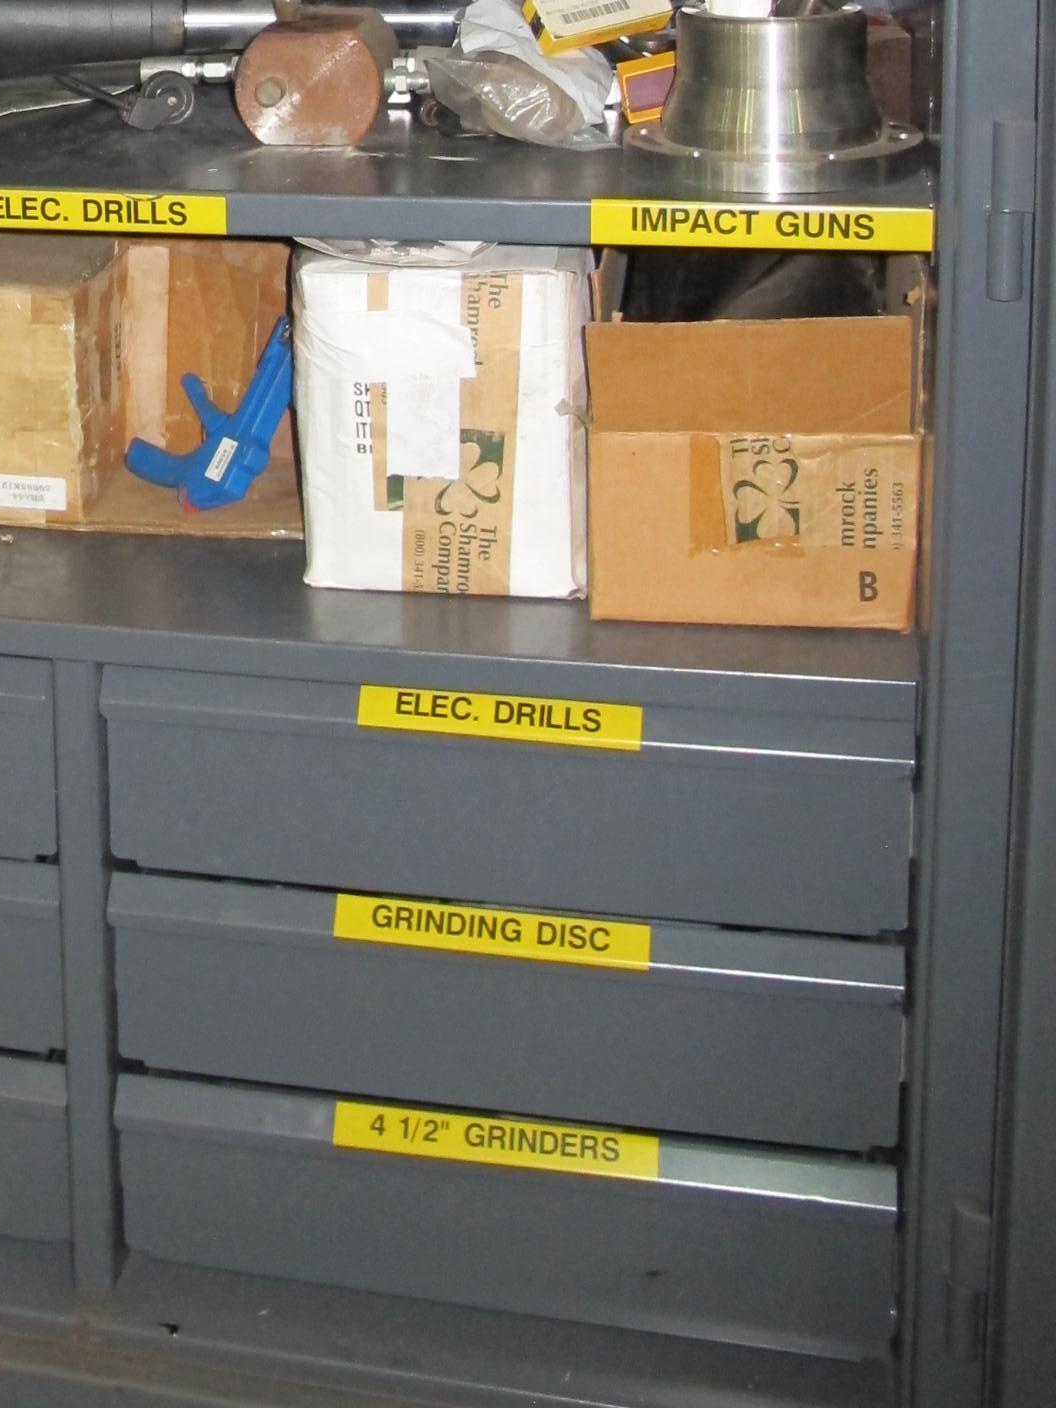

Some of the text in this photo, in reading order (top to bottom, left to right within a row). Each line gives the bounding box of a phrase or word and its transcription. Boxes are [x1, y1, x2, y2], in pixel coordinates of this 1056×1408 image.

[83, 198, 187, 226] DRILLS
[631, 207, 875, 240] IMPACT GUNS
[835, 481, 856, 547] mrock
[891, 482, 904, 538] 341-5563
[414, 529, 425, 557] (800)
[478, 526, 498, 561] The
[858, 571, 879, 602] B
[395, 691, 602, 733] ELEC. DRILLS
[371, 904, 612, 952] GRINDING DISC
[369, 1114, 620, 1163] 4 1/2" GRINDERS
